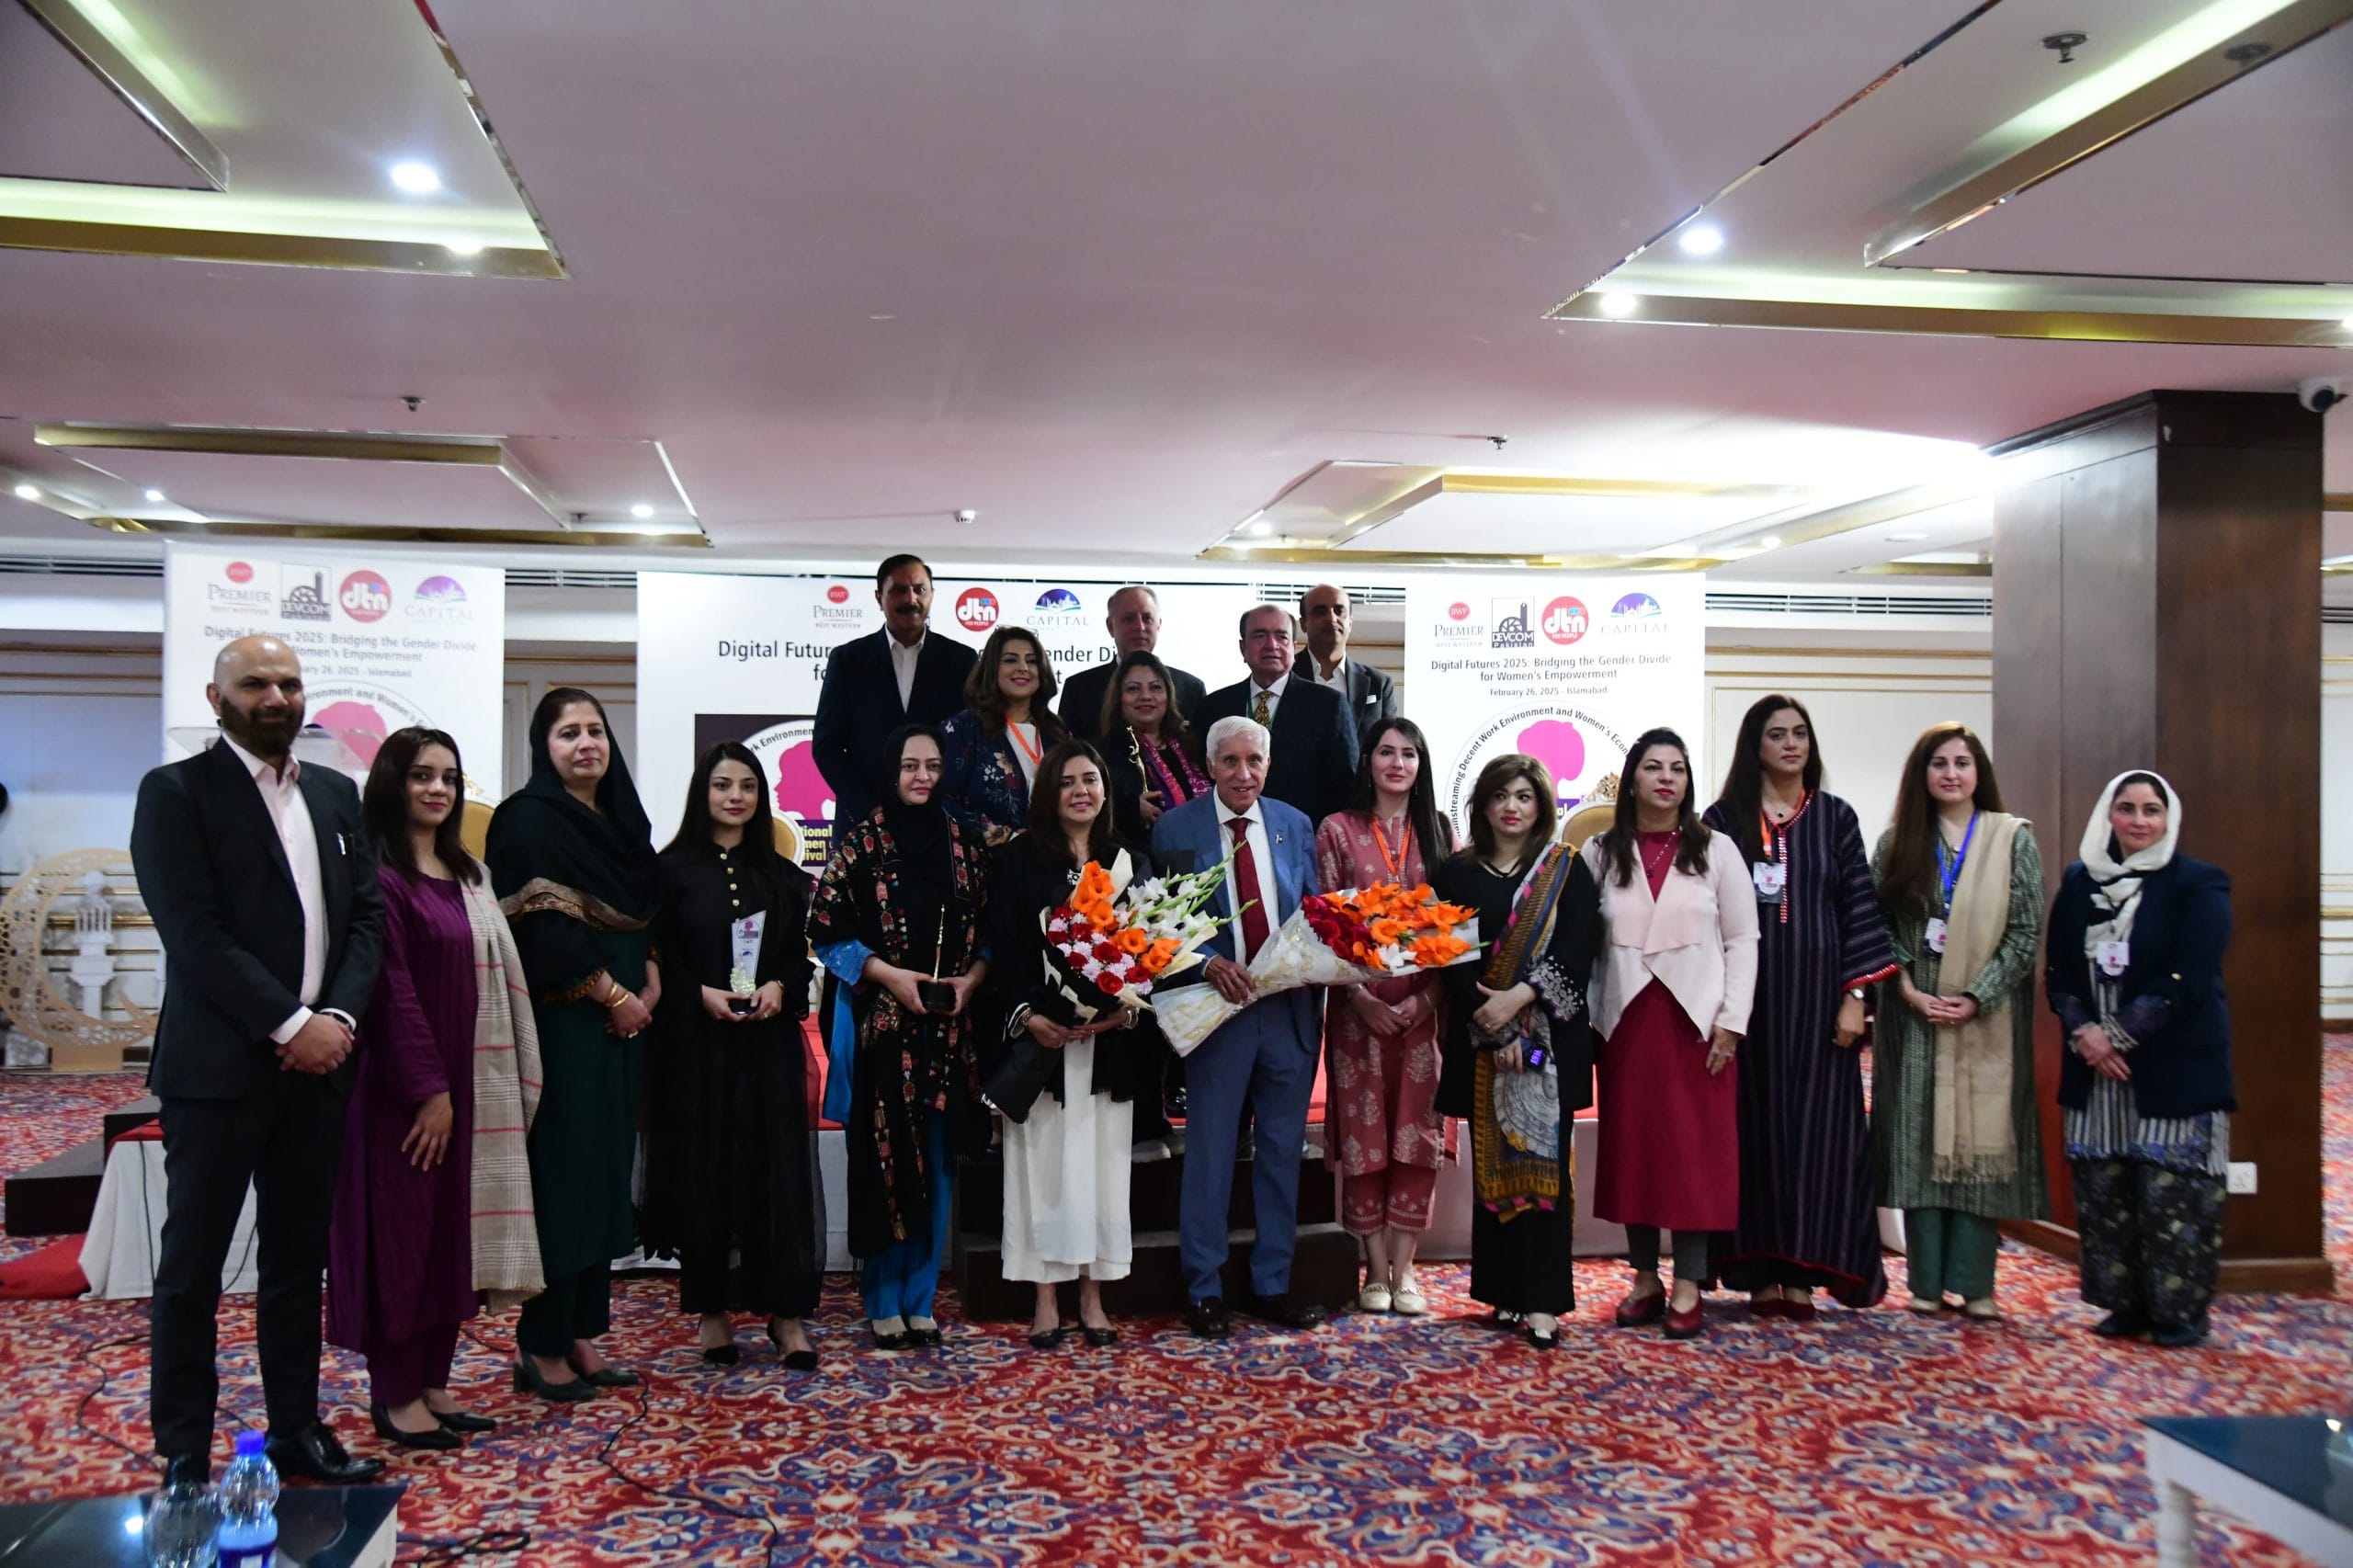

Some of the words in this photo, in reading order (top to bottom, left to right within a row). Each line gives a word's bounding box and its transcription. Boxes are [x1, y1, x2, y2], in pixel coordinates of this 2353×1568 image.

[208, 584, 271, 603] PREMIER
[813, 605, 863, 619] PREMIER
[1451, 608, 1468, 616] BWP
[1027, 616, 1088, 626] CAPITAL
[1434, 624, 1484, 637] PREMIER
[1601, 623, 1670, 635] CAPITAL
[204, 626, 244, 640] Digital
[331, 633, 378, 648] Bridging
[381, 636, 399, 647] the
[403, 638, 439, 650] Gender
[444, 640, 477, 652] Divide
[1493, 632, 1534, 642] DEVCOM
[344, 649, 423, 662] Empowerment
[719, 641, 778, 662] Digital
[786, 642, 832, 658] Futur
[1045, 645, 1092, 662] ender
[1431, 659, 1462, 672] Digital
[1466, 658, 1500, 669] Futures
[1503, 658, 1530, 668] 2025:
[1534, 656, 1575, 669] Bridging
[1579, 655, 1595, 666] the
[1598, 655, 1634, 665] Gender
[1639, 653, 1671, 664] Divide
[1480, 672, 1495, 681] for
[1496, 671, 1541, 680] Women's
[1544, 669, 1618, 681] Empowerment
[357, 689, 374, 699] and
[1490, 688, 1523, 698] February
[1567, 686, 1608, 694] Islamabad
[760, 729, 814, 746] Environmen
[1459, 741, 1482, 771] Decent
[1478, 723, 1500, 743] Work
[1499, 706, 1553, 728] Environment
[1556, 708, 1573, 718] and
[1610, 733, 1629, 756] Econ
